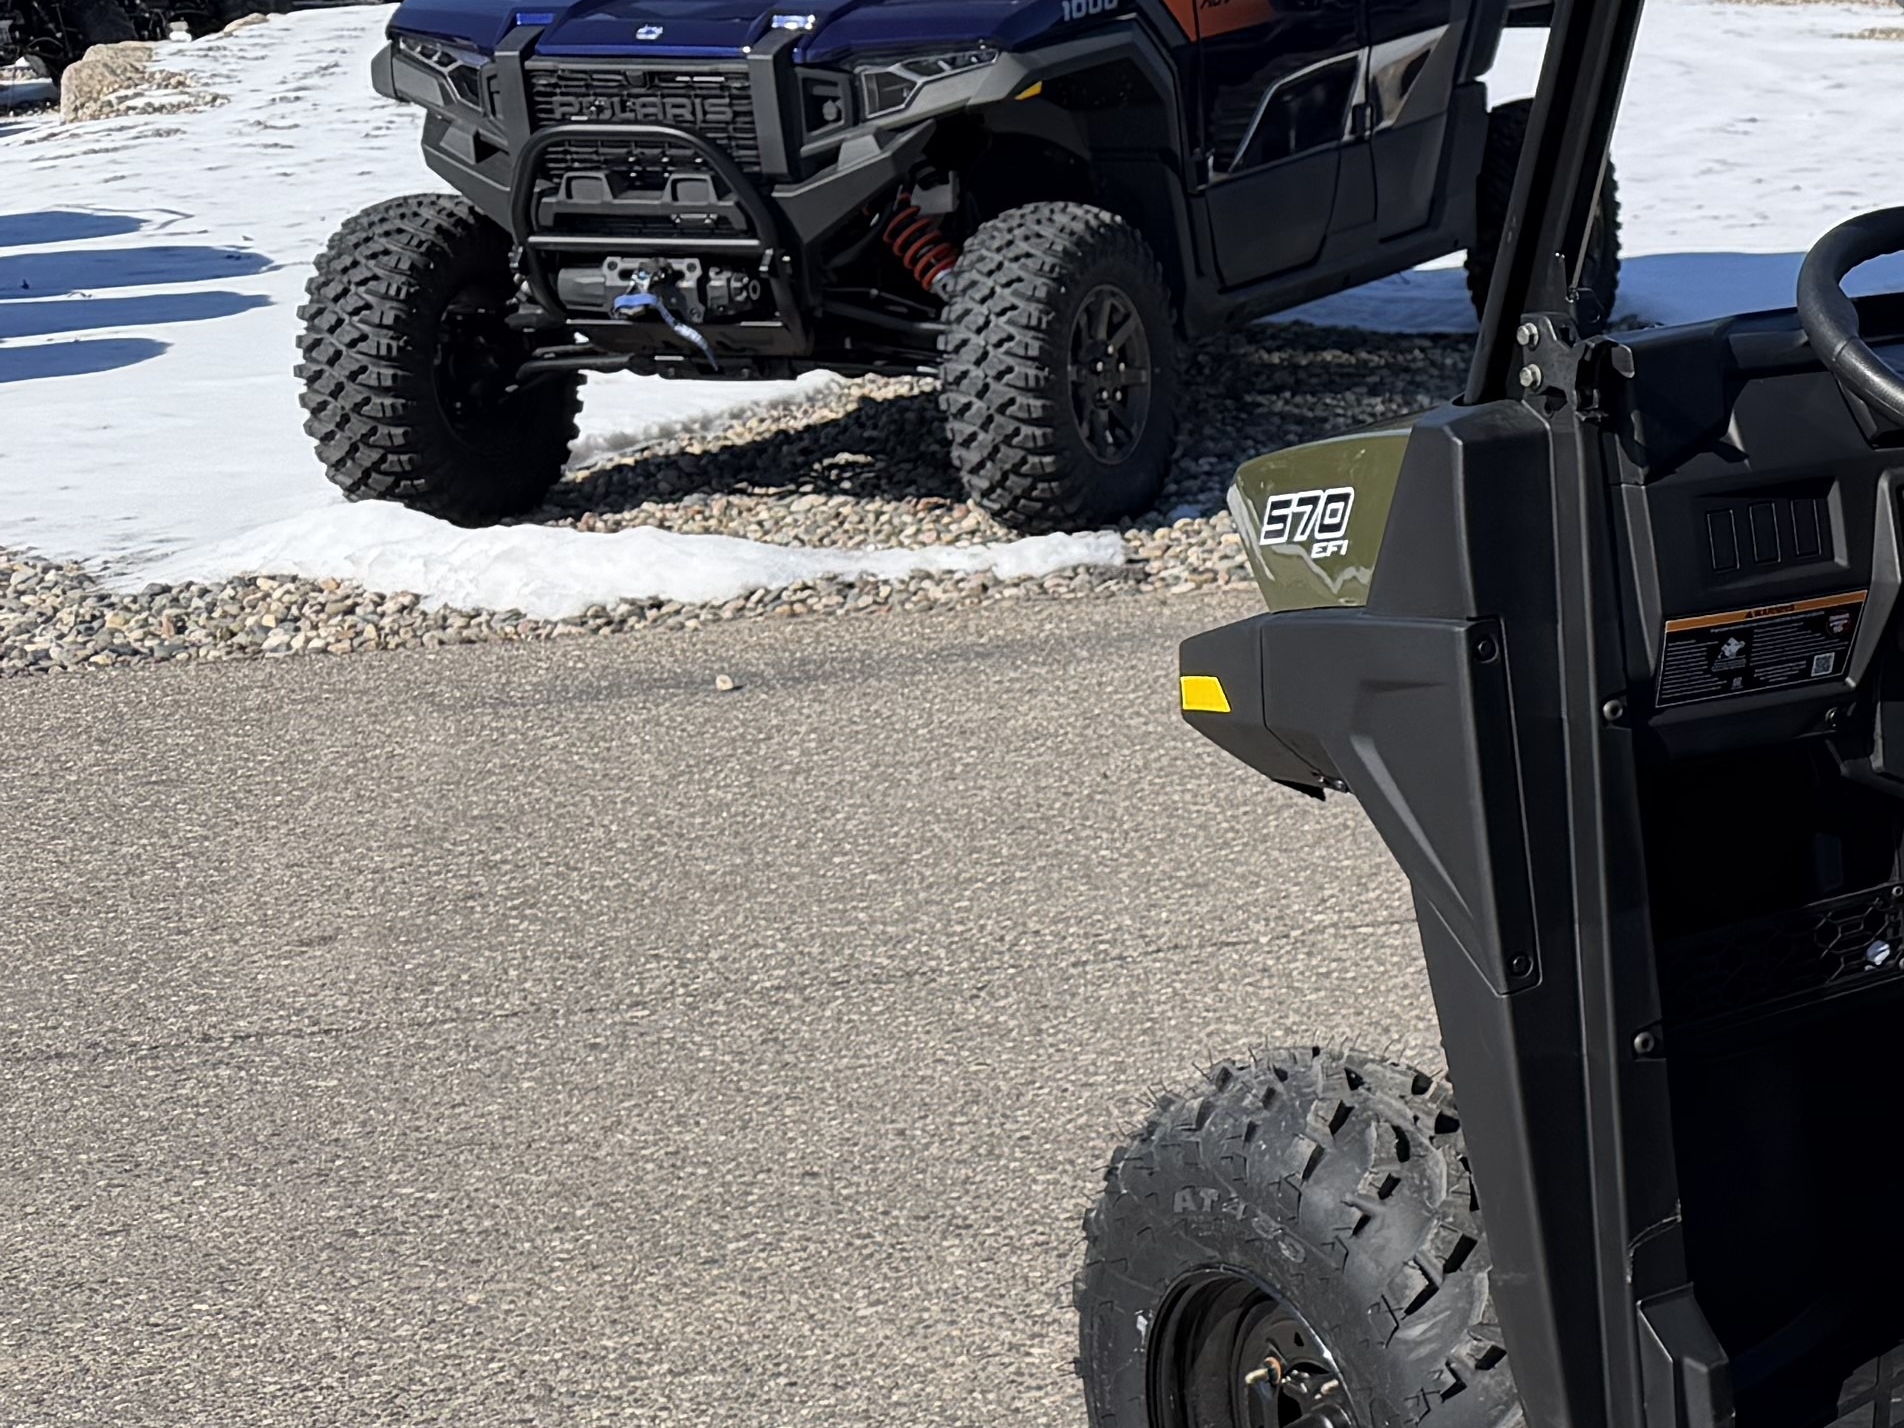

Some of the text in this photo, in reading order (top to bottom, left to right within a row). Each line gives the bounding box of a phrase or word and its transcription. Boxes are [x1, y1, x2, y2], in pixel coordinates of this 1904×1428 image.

[553, 97, 732, 121] POLARIS
[1260, 487, 1354, 545] 570
[1311, 539, 1348, 558] EFI
